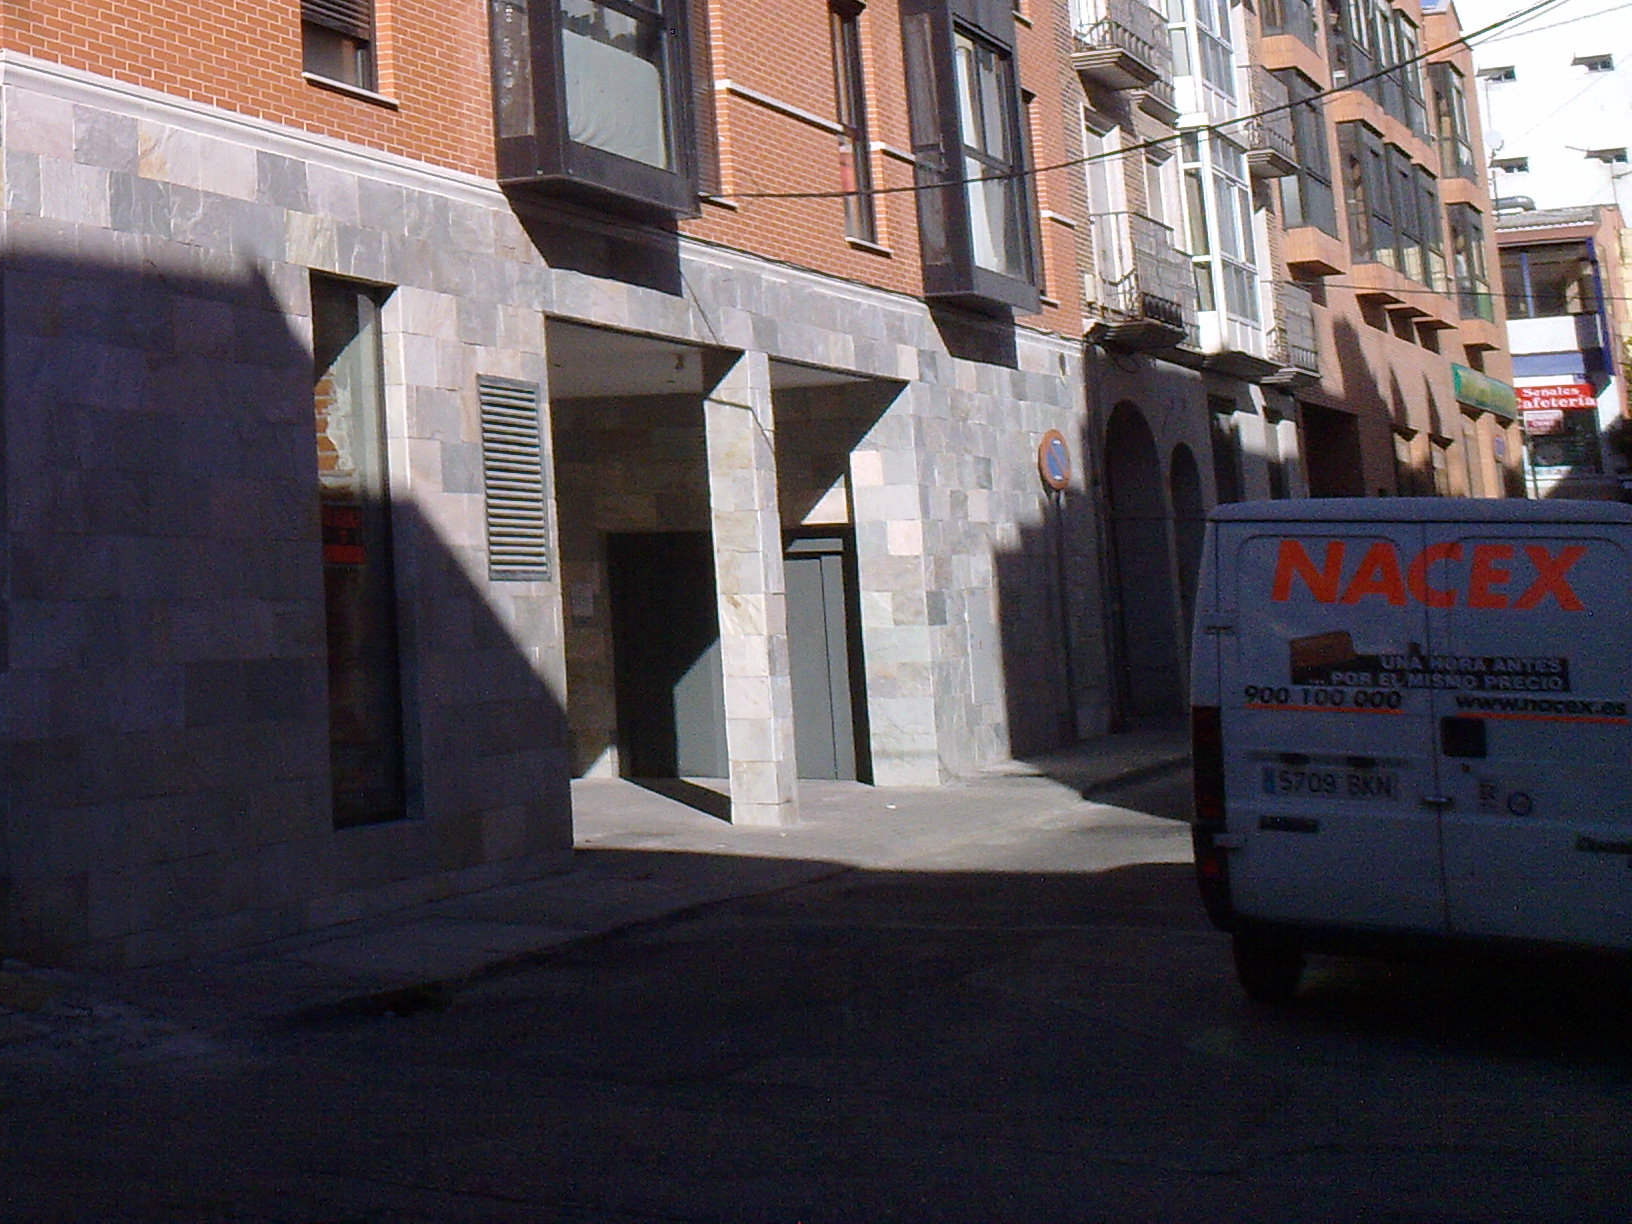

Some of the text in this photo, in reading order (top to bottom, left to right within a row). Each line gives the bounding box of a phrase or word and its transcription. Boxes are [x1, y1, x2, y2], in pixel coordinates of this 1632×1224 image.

[1271, 539, 1589, 612] NACEX
[1380, 652, 1562, 675] UNA HORA ANTES
[1330, 671, 1374, 688] POR
[1380, 672, 1405, 689] EL
[1406, 673, 1479, 691] MISMO
[1486, 674, 1563, 692] PRECIO
[1245, 685, 1626, 716] 900 100 000 www.nacex.es
[1278, 771, 1337, 794] 5709
